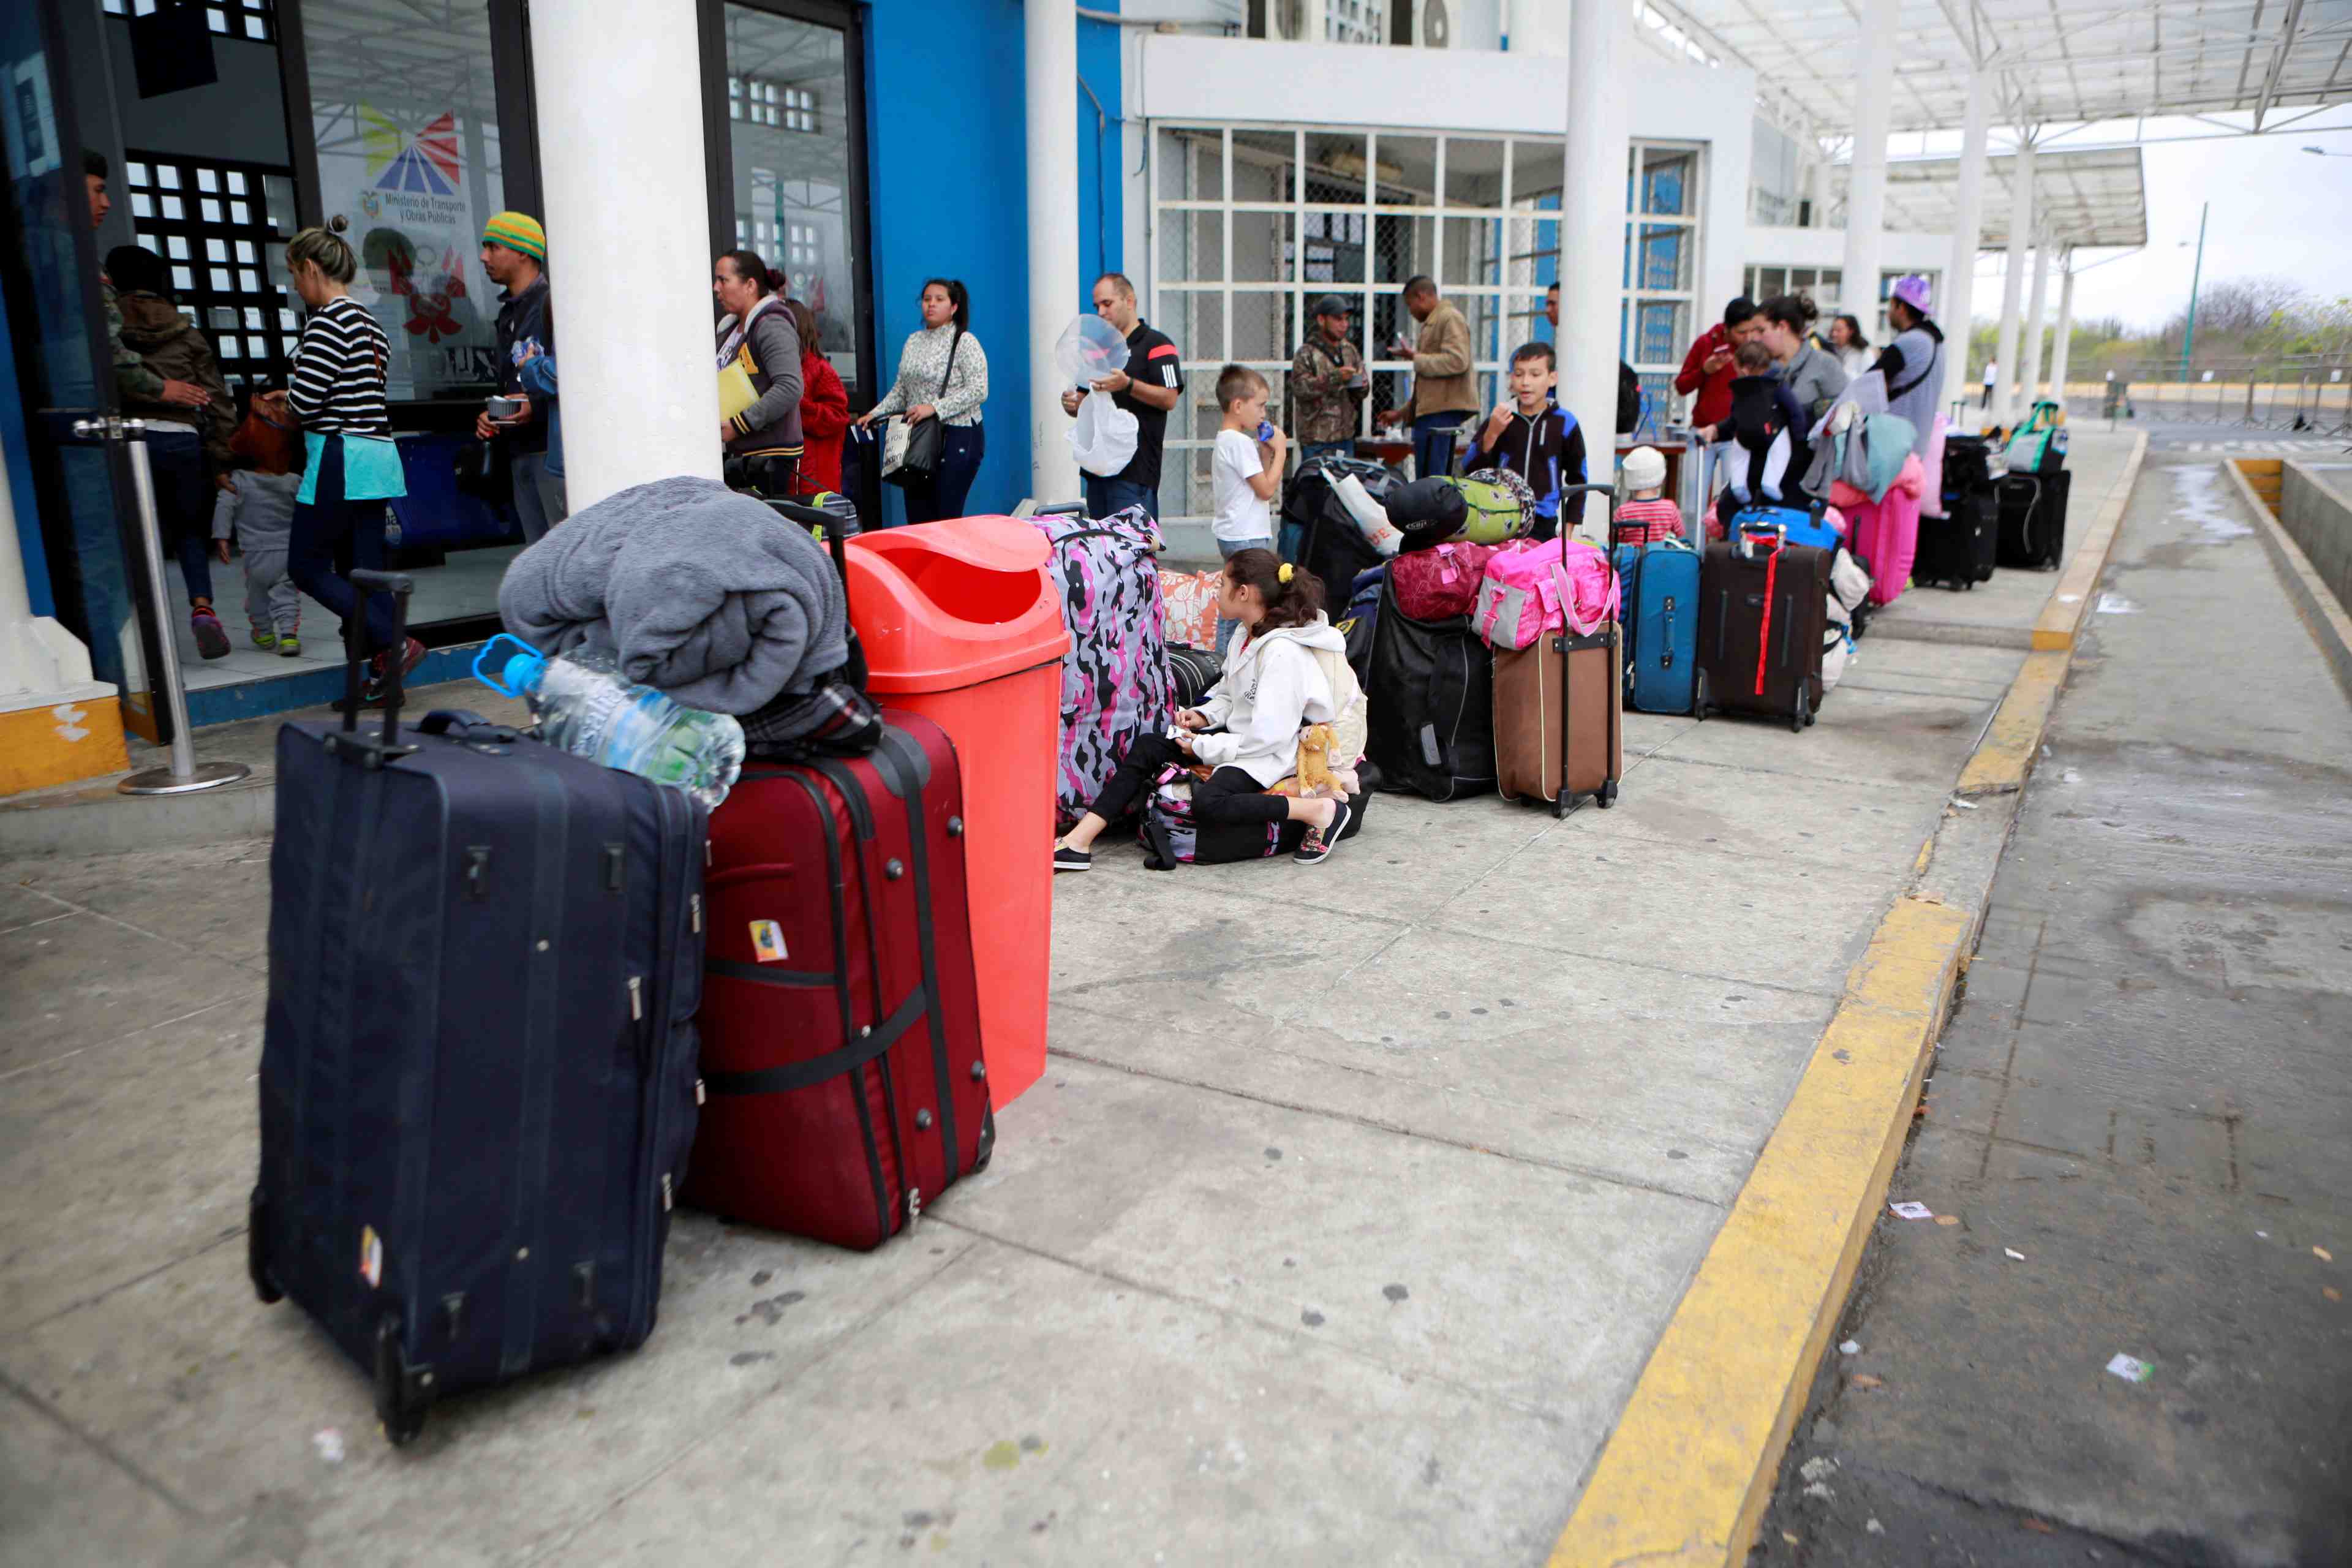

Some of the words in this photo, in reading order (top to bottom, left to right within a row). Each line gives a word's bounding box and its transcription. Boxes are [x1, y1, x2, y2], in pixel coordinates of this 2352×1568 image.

[385, 193, 420, 208] Ministerio
[421, 198, 430, 209] de
[431, 197, 466, 213] Transporte
[400, 211, 404, 223] y
[405, 209, 427, 222] Obras
